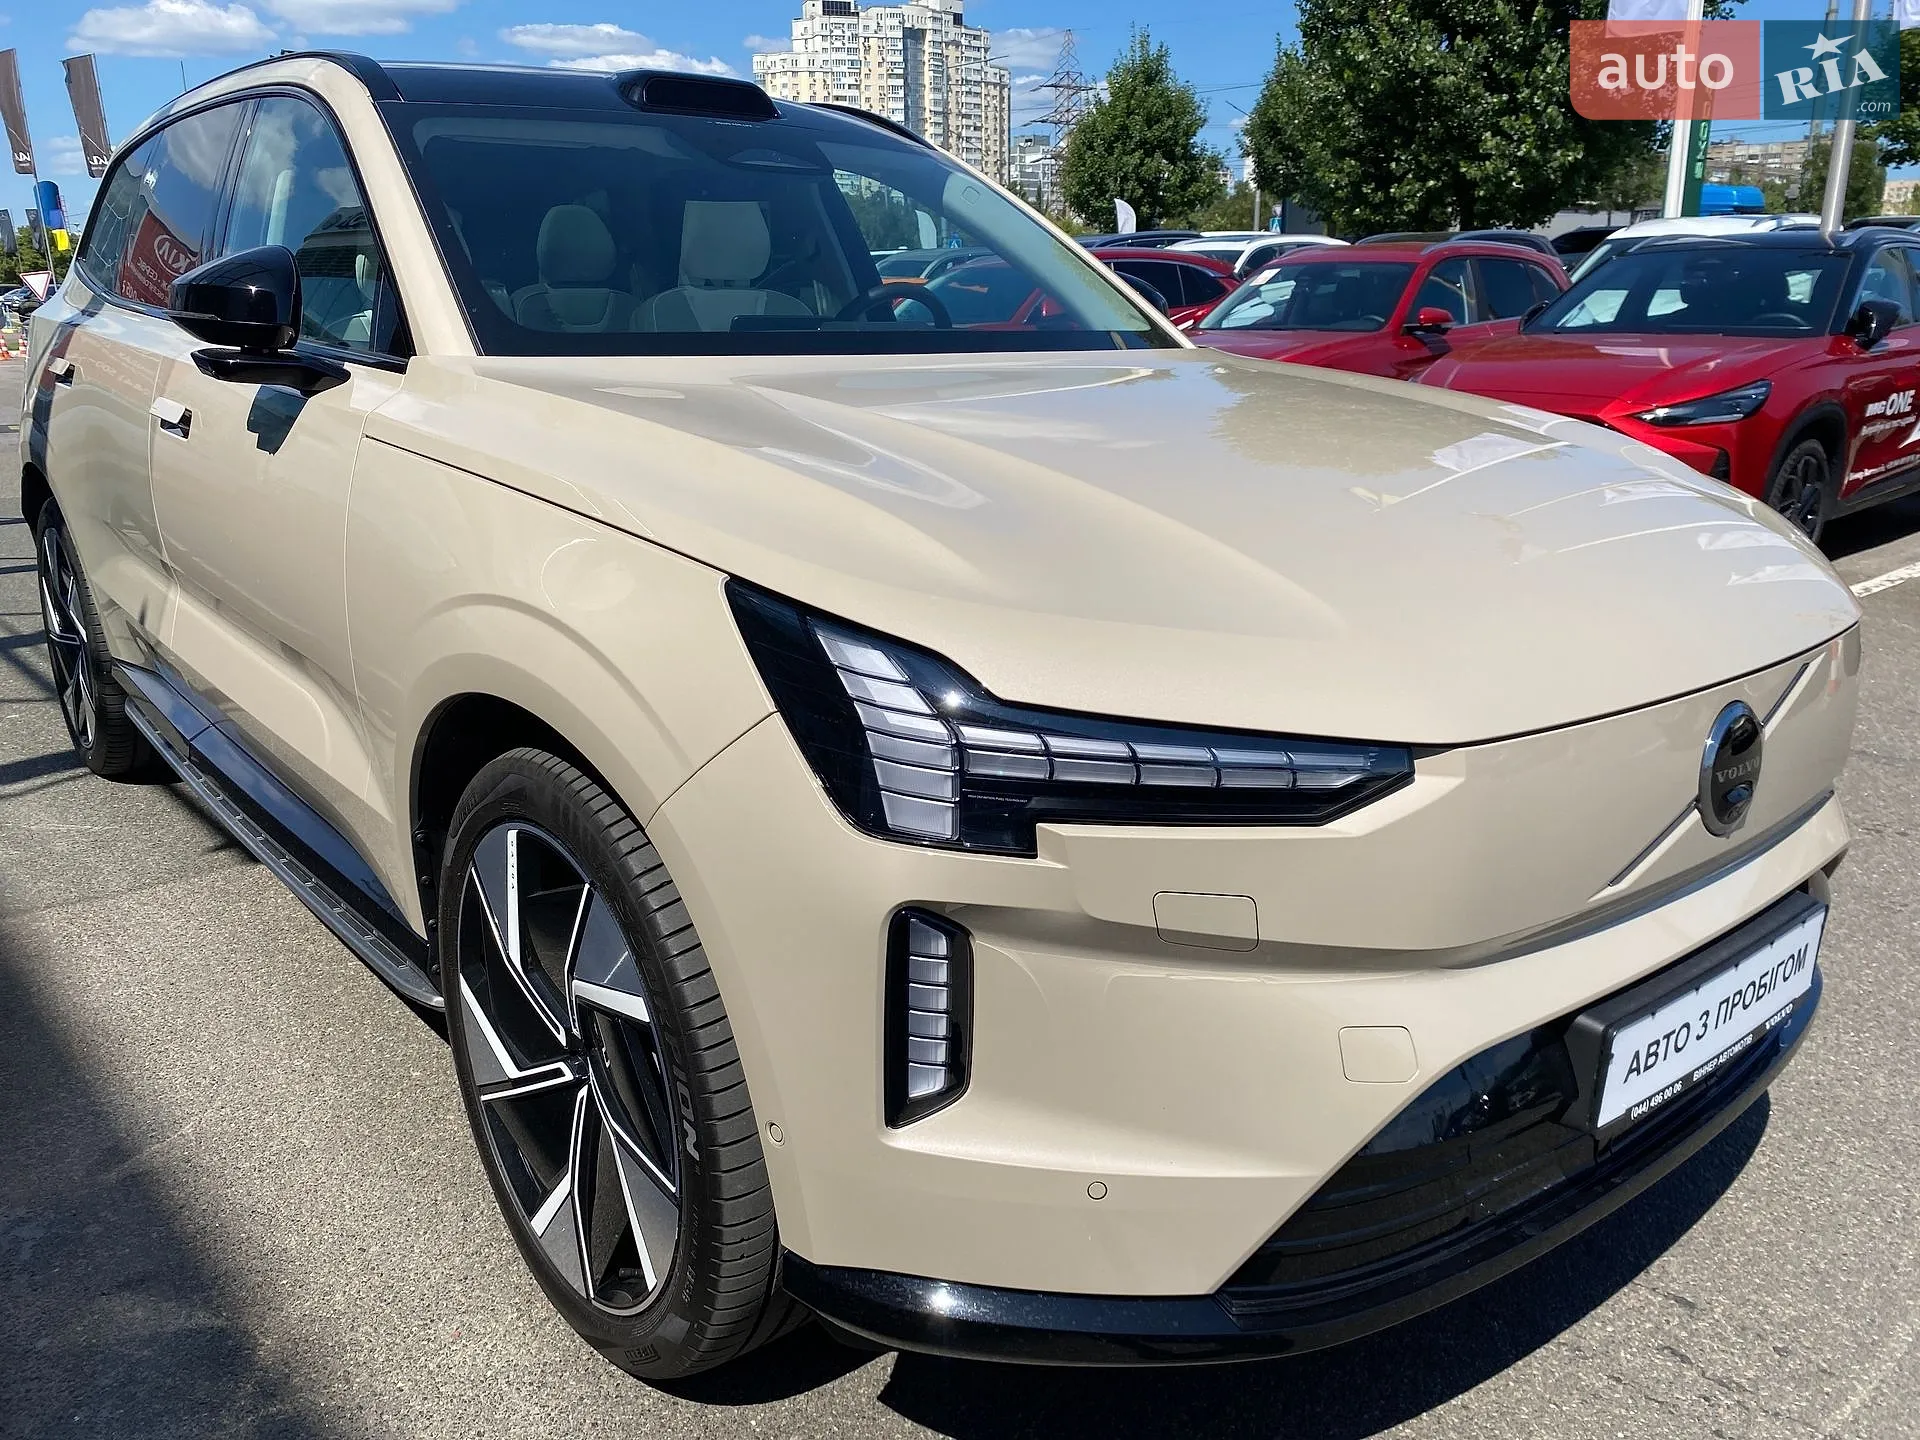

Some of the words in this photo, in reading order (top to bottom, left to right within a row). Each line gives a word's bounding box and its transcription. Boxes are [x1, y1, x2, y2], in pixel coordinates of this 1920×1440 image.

[1885, 389, 1916, 416] ONE
[1715, 755, 1760, 783] VOLVO
[1623, 1021, 1690, 1084] АВТО
[1714, 943, 1809, 1030] ПРОБІГОМ
[1631, 1098, 1650, 1120] (044)
[1650, 1092, 1663, 1107] 496
[1664, 1086, 1673, 1100] 00
[1673, 1080, 1682, 1094] 06
[1693, 1058, 1718, 1081] ВІННЕР
[1765, 1003, 1793, 1030] VOLVO
